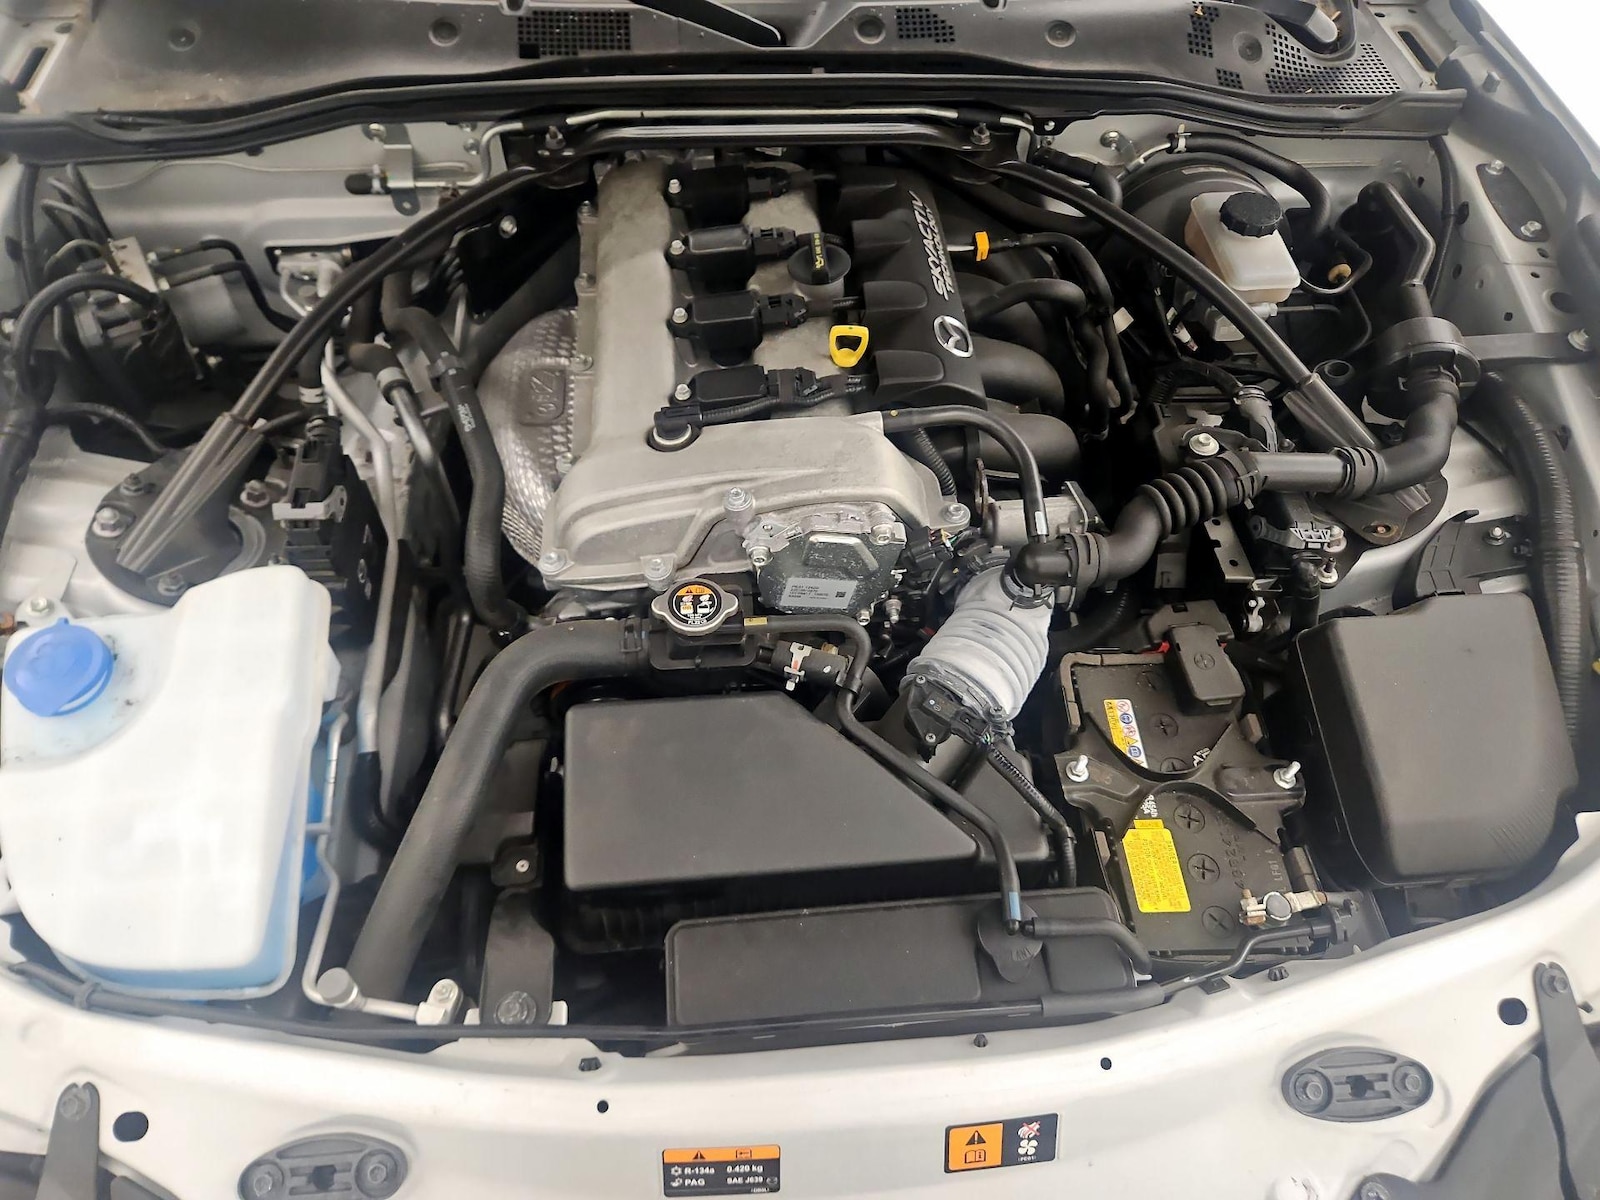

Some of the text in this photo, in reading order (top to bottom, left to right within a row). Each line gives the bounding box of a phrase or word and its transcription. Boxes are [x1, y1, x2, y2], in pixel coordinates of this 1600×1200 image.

[909, 190, 949, 300] SKYACTIV
[684, 1164, 764, 1176] R-134a 0.420 kg
[684, 1178, 706, 1187] PAG
